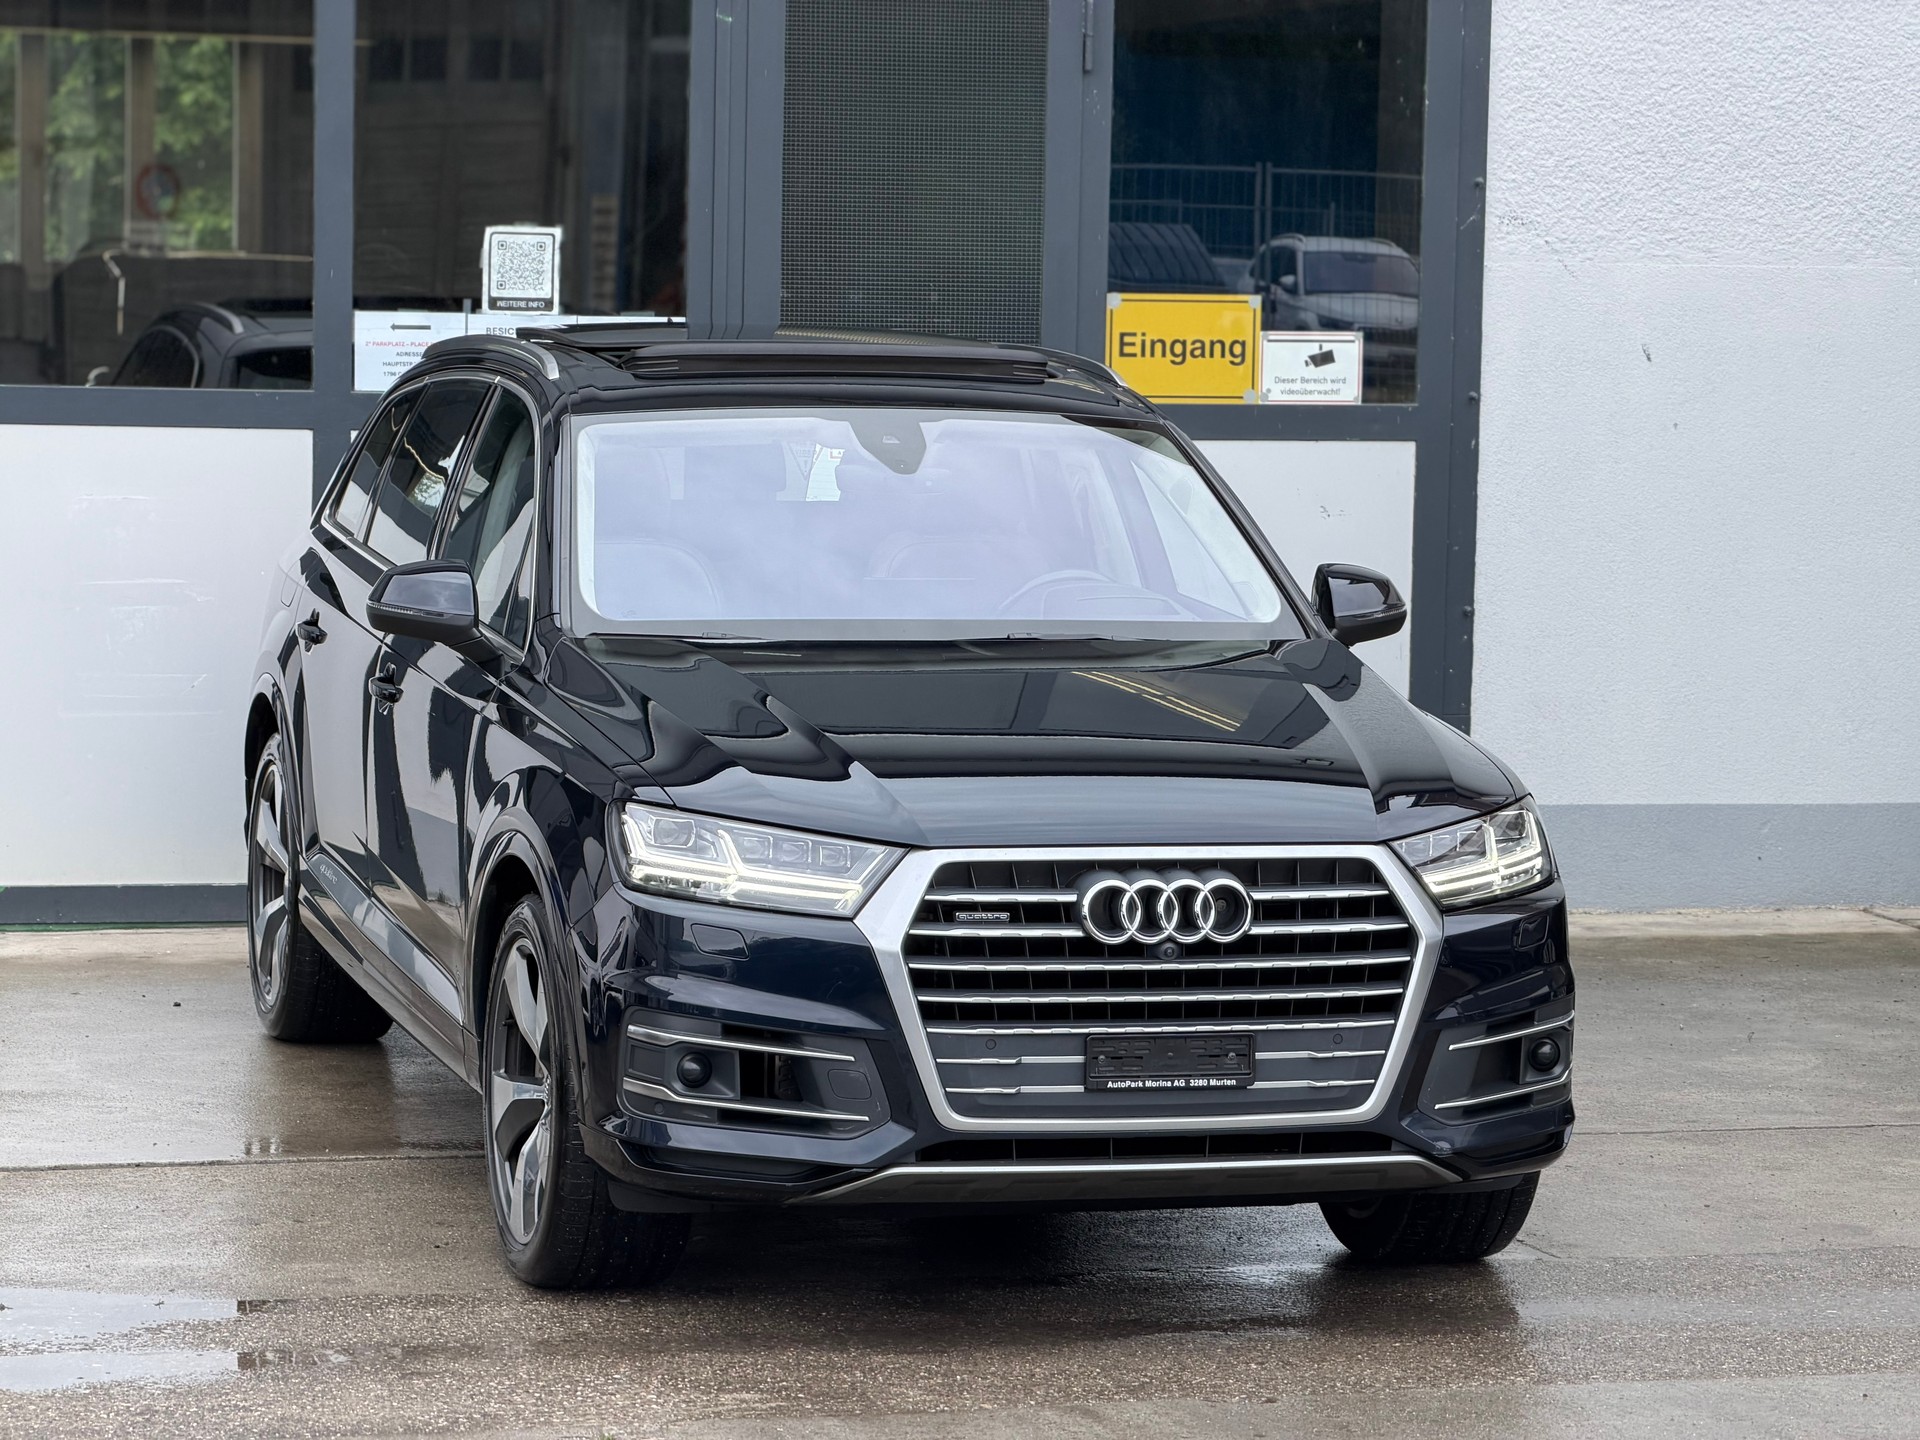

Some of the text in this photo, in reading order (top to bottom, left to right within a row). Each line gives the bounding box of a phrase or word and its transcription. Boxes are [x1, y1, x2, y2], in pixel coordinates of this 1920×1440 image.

[497, 300, 527, 308] WEITERE
[486, 327, 516, 335] BESIC
[1118, 331, 1247, 366] Eingang
[1274, 376, 1347, 384] Dieser Bereich wird
[1280, 387, 1341, 395] videoüberwacht!
[958, 913, 1008, 921] quattro
[1107, 1080, 1143, 1088] AutoPark
